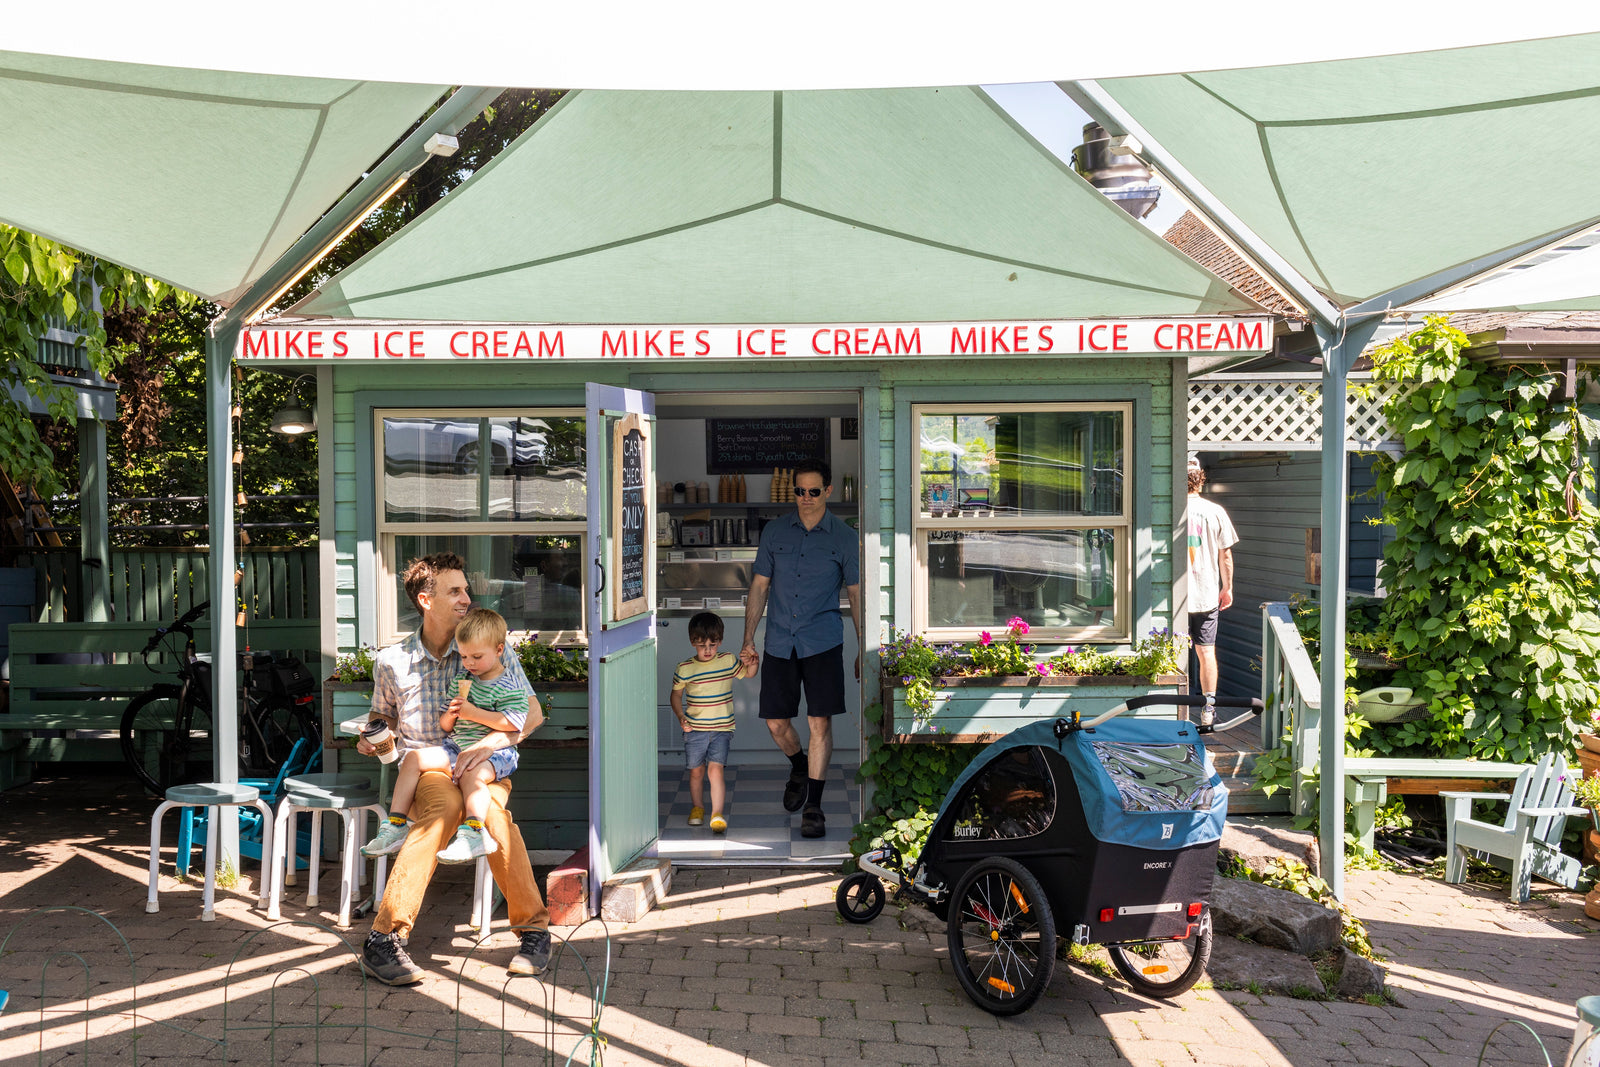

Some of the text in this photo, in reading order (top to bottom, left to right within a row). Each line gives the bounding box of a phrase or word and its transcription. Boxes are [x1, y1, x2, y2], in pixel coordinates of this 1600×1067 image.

[374, 331, 425, 358] ICE
[449, 331, 565, 357] CREAM
[737, 330, 787, 356] ICE
[812, 328, 922, 355] CREAM
[1079, 324, 1129, 351] ICE
[1154, 323, 1264, 350] CREAM
[717, 434, 735, 442] Berry
[736, 434, 758, 442] Banana
[623, 440, 642, 456] CASH
[631, 493, 640, 503] YOU
[622, 506, 645, 530] ONLY
[954, 824, 983, 838] Burley
[1143, 861, 1168, 870] ENCORE
